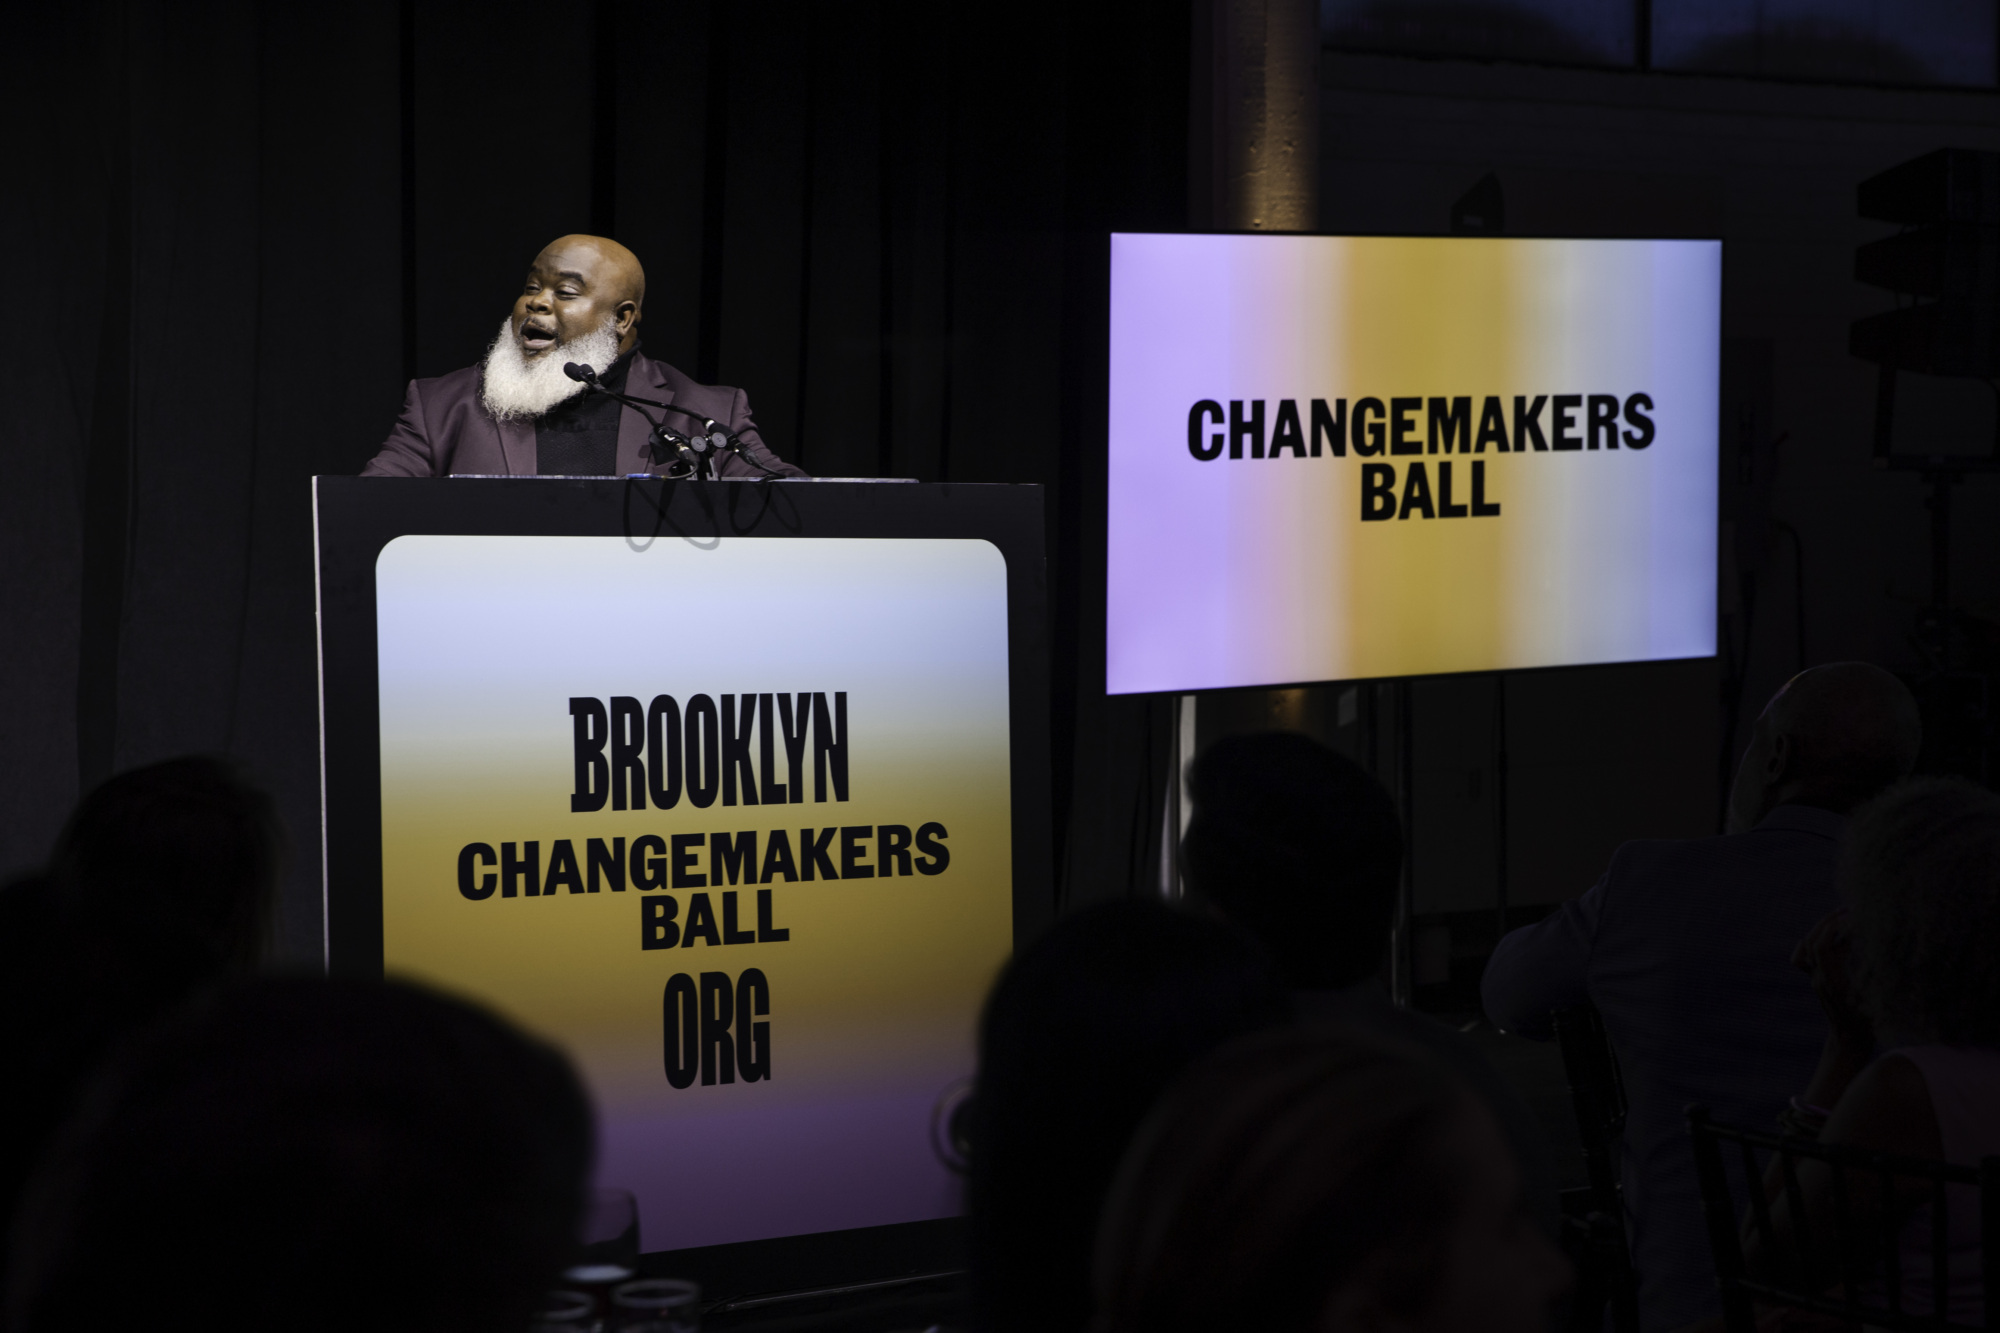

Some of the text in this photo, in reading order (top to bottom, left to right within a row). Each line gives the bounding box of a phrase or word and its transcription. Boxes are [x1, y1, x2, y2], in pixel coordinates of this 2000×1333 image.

[1187, 392, 1656, 462] CHANGEMAKERS
[1360, 459, 1501, 522] BALL
[569, 691, 849, 813] BROOKLYN
[457, 821, 950, 901] CHANGEMAKERS
[641, 889, 790, 951] BALL
[663, 967, 771, 1090] ORG
